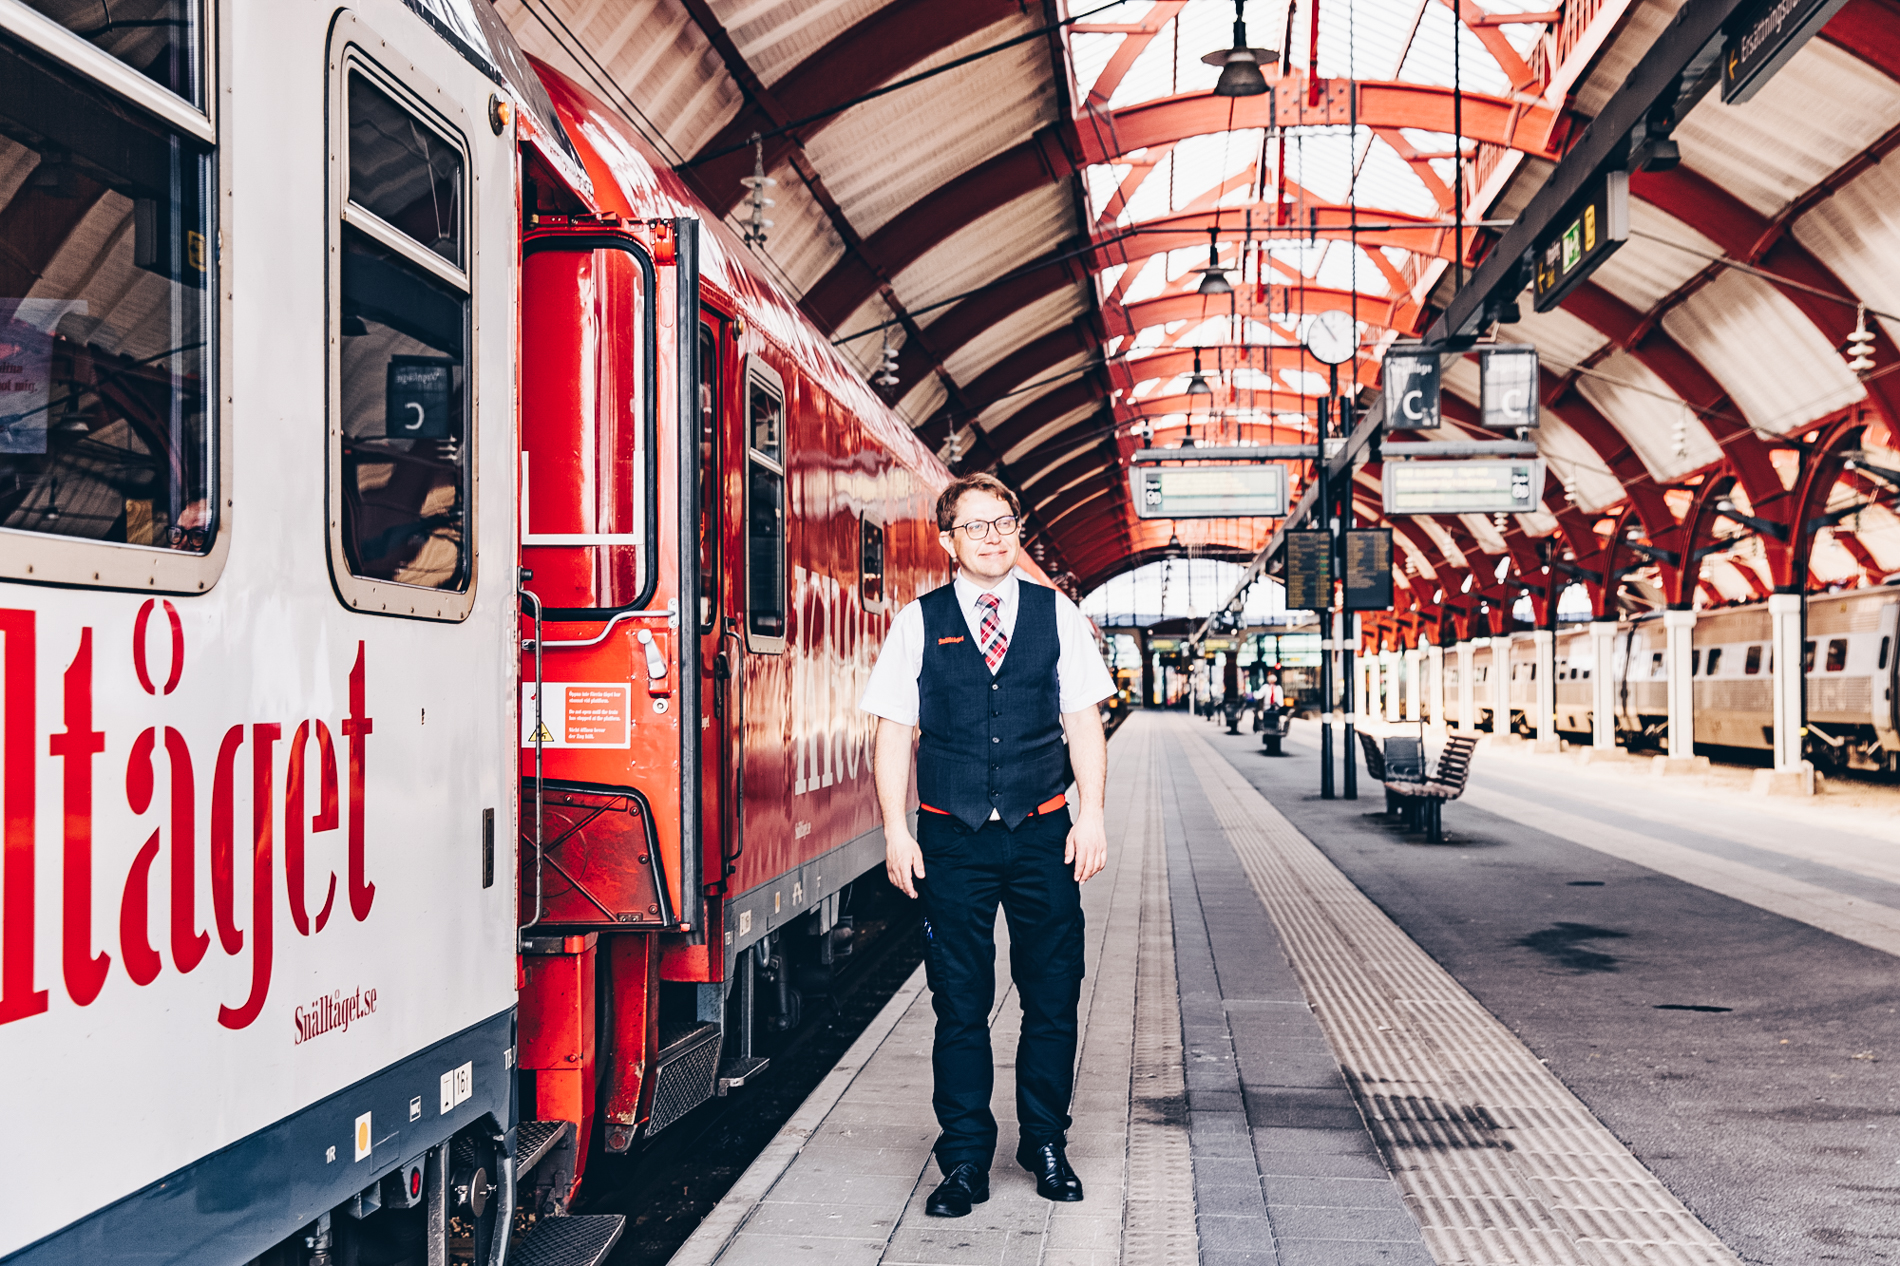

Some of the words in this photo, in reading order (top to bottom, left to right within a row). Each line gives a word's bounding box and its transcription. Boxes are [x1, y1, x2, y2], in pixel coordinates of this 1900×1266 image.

[1402, 389, 1423, 420] C
[1502, 388, 1523, 418] C
[294, 985, 377, 1046] Snälltåget.se
